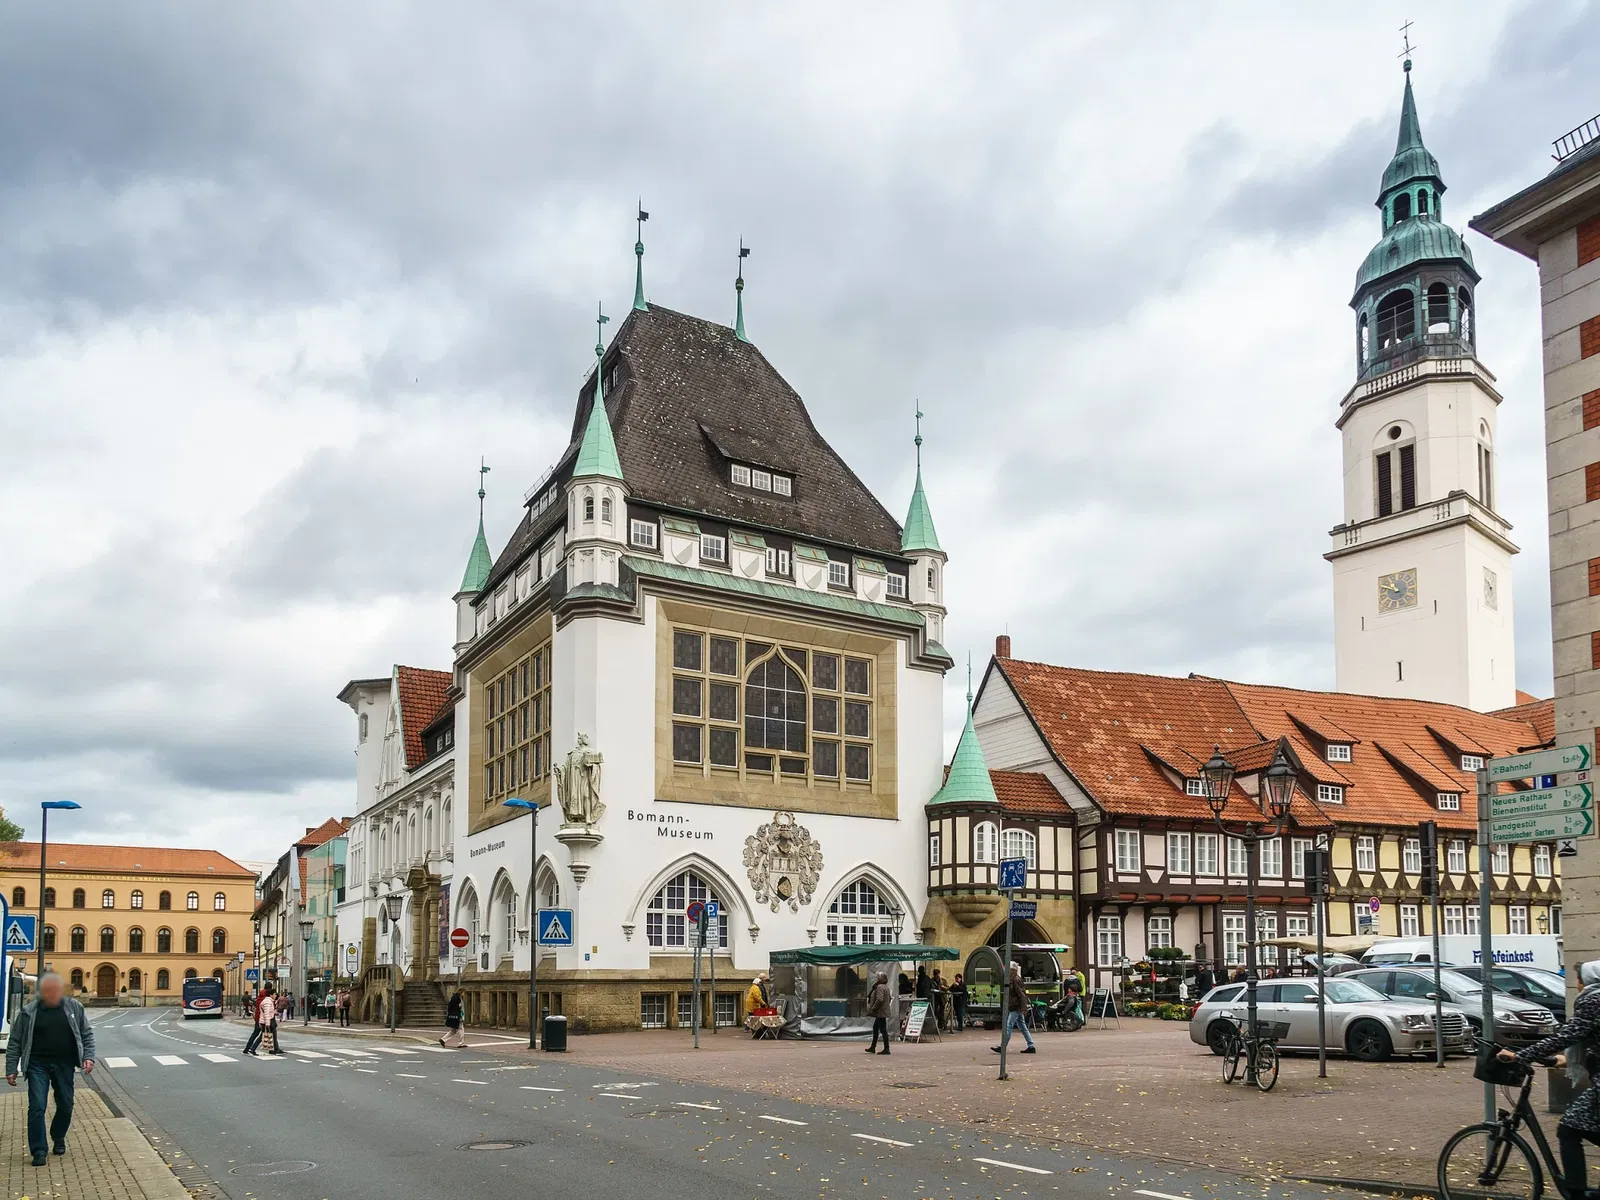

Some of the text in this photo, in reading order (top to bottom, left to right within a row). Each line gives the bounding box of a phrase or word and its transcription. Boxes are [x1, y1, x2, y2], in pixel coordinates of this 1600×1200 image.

[1499, 761, 1532, 773] Bahnhof
[1492, 796, 1517, 806] Neues
[1520, 793, 1553, 803] Rathaus
[1492, 803, 1547, 816] Bieneninstitut
[628, 809, 690, 824] Bomann-
[1492, 820, 1536, 831] Landgestüt
[657, 826, 713, 840] Museum
[1535, 828, 1556, 837] Garten
